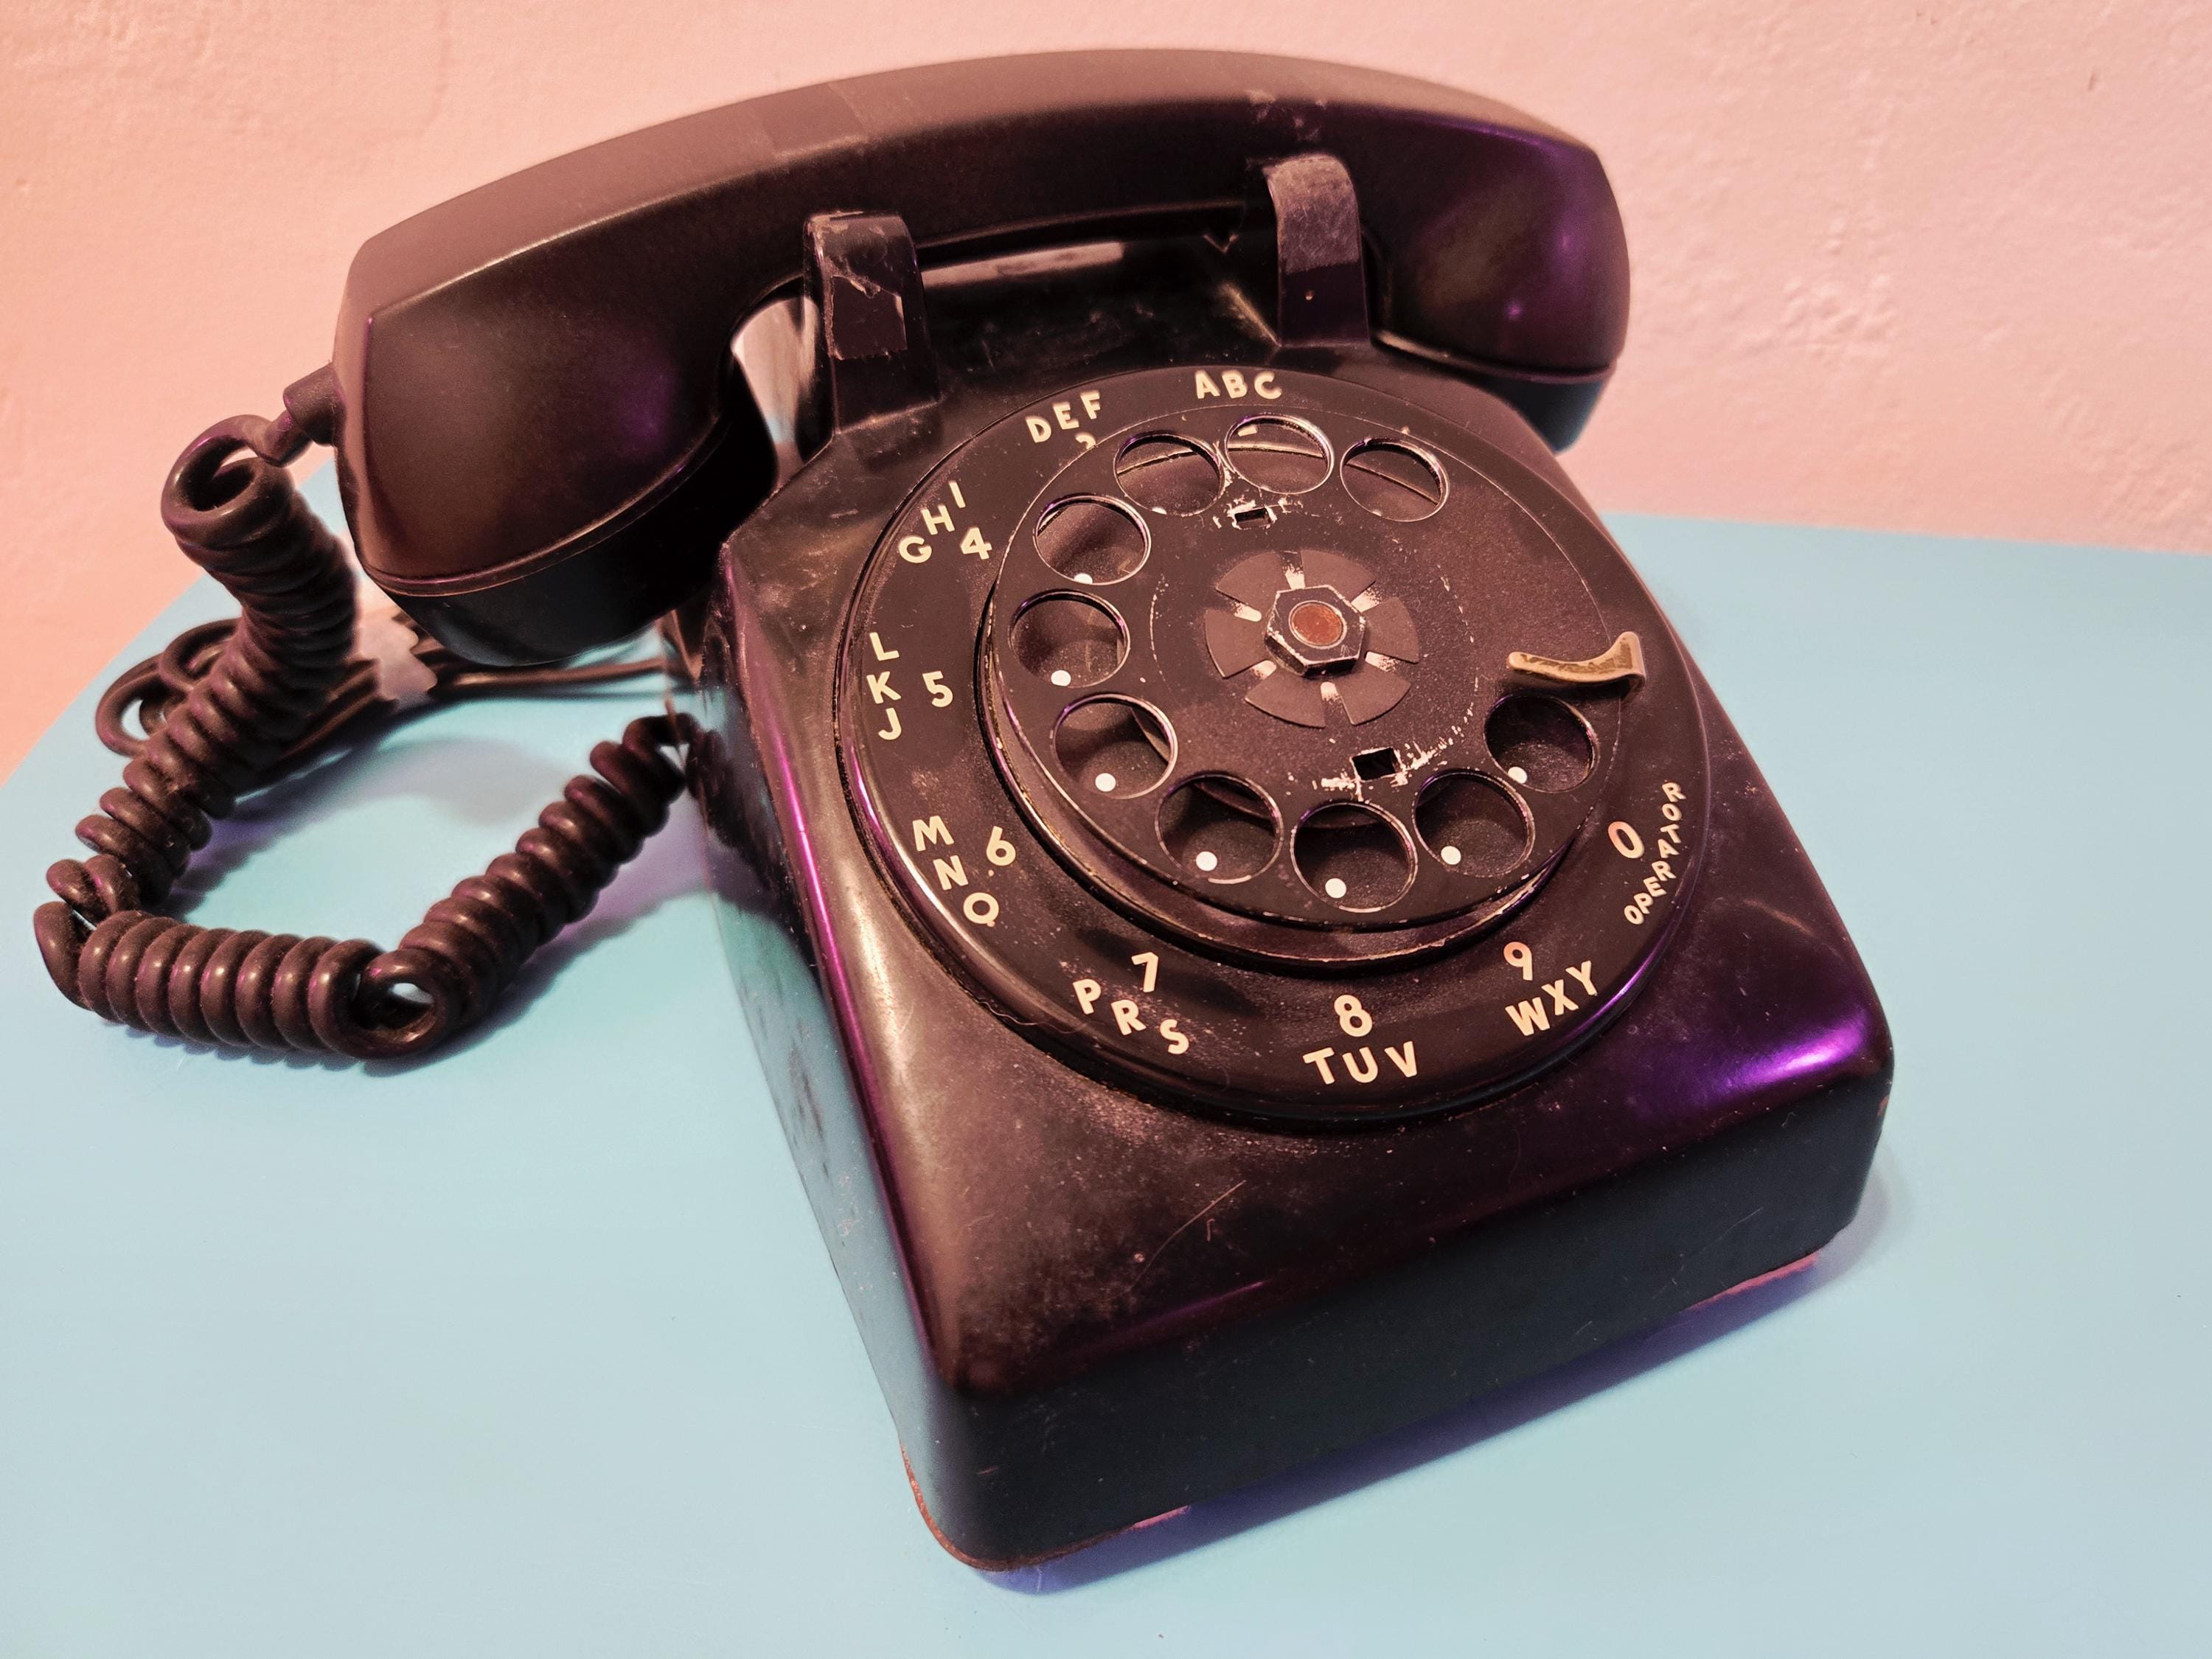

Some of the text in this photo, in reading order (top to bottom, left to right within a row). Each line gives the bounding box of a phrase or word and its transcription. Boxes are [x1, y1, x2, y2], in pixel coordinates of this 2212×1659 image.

[1194, 369, 1283, 400] ABC
[1024, 389, 1102, 444] DEF
[897, 479, 967, 564] GHI
[959, 526, 993, 561] 4
[921, 669, 954, 709] 5
[984, 824, 1017, 867] 6
[1623, 782, 1686, 925] OPERATOR
[1130, 951, 1160, 993] 7
[1502, 941, 1534, 981] 9
[1071, 978, 1190, 1055] PRS
[1332, 994, 1374, 1038] 8
[1504, 959, 1598, 1037] WXY
[1301, 1040, 1418, 1085] TUV
